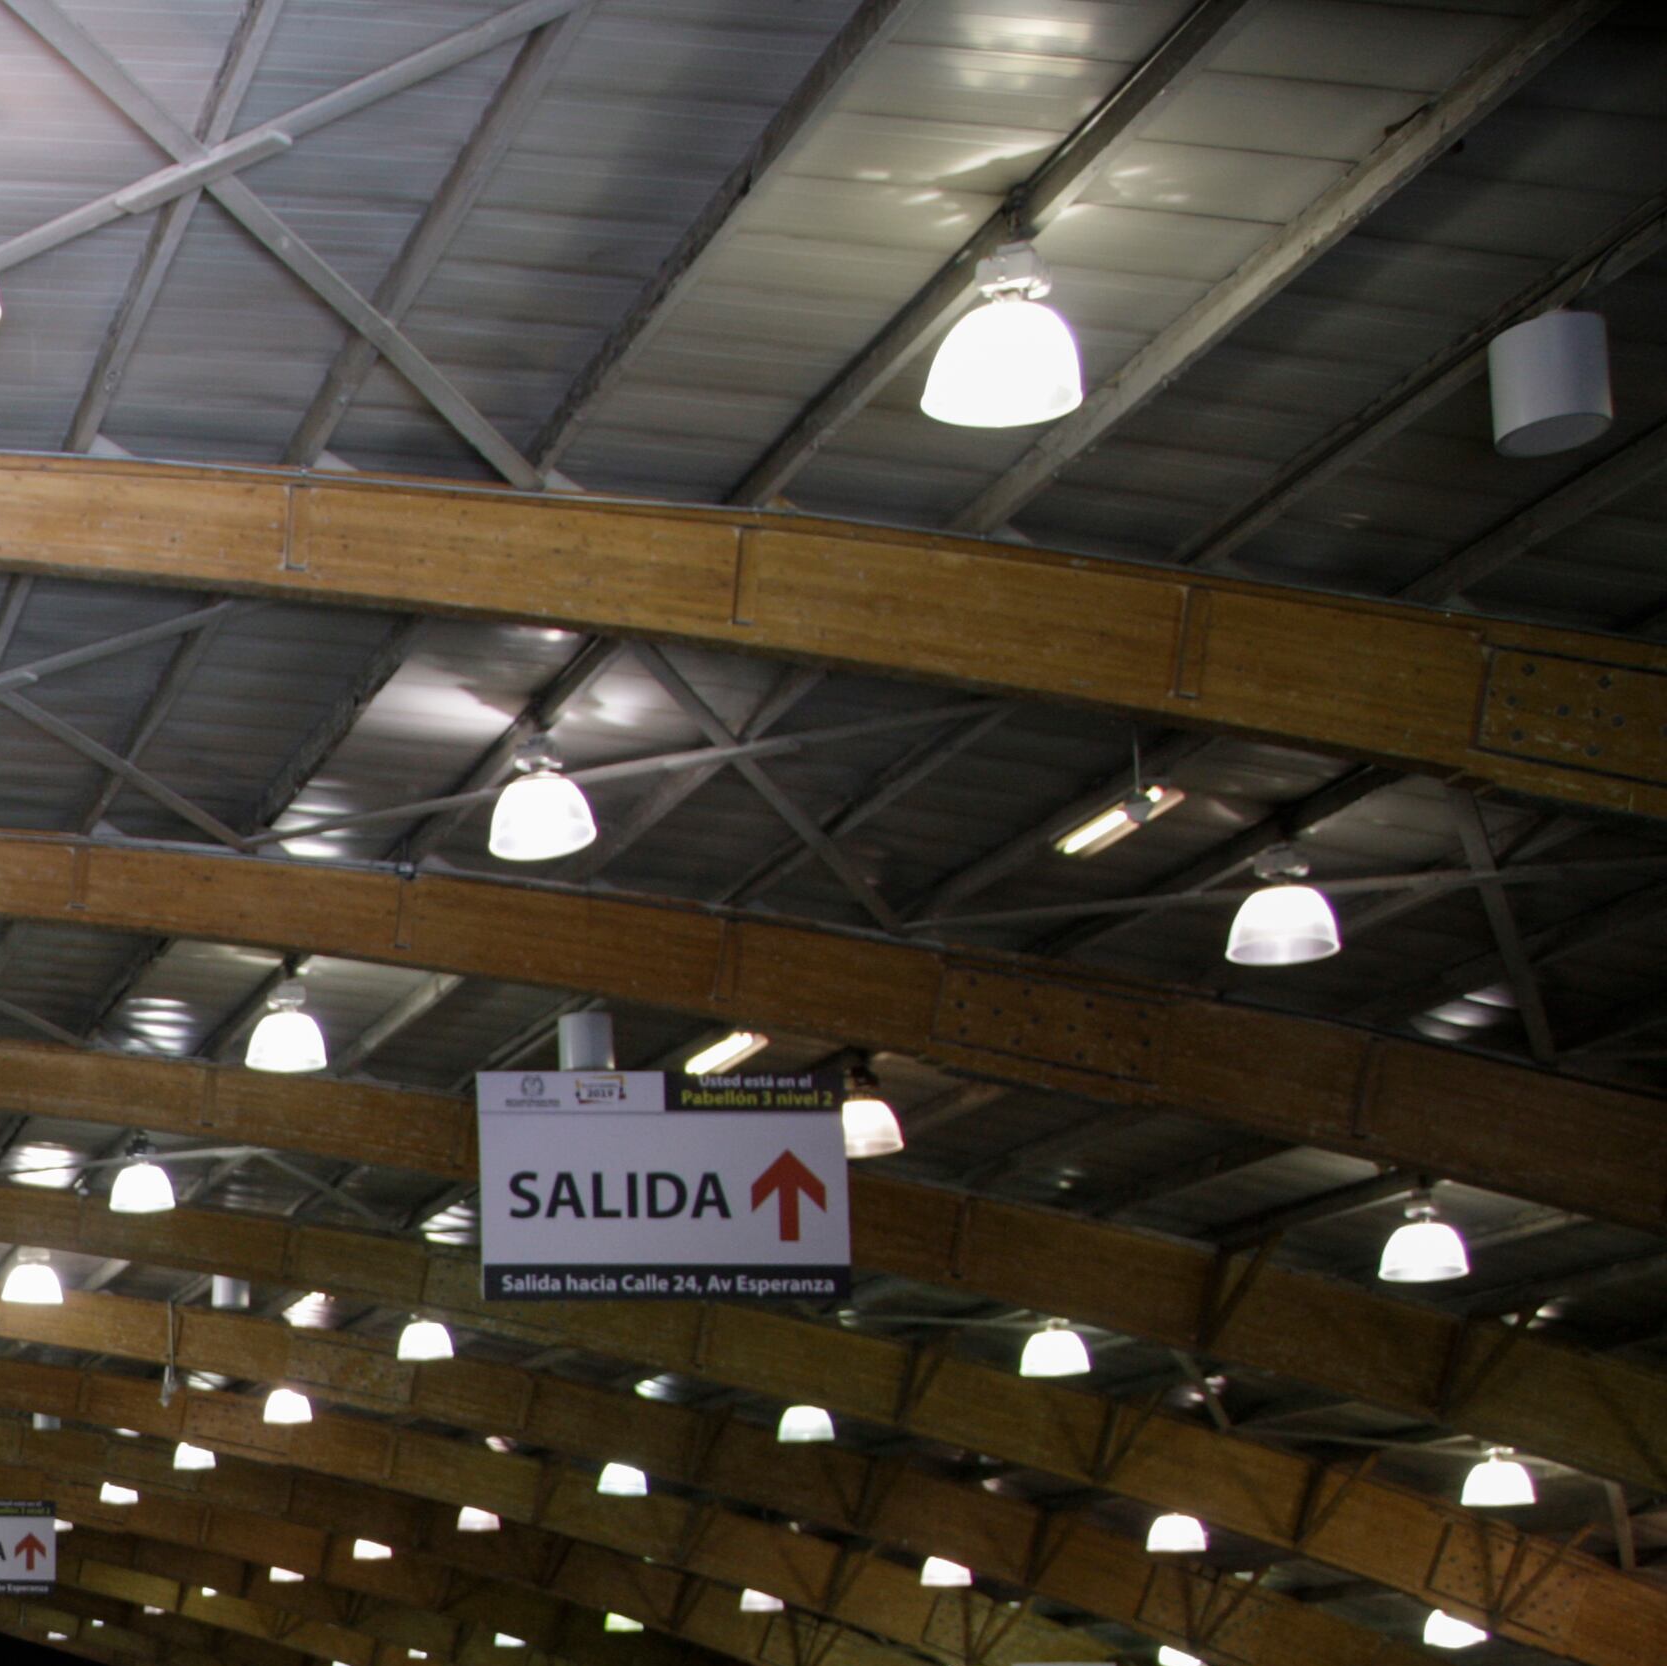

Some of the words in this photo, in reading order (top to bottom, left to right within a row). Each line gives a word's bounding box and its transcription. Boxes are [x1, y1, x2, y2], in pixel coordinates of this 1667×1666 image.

[698, 1074, 740, 1089] Usted
[743, 1073, 773, 1089] está
[778, 1077, 796, 1089] en
[799, 1074, 812, 1089] el
[681, 1090, 757, 1107] Pabellón
[761, 1091, 772, 1106] 3
[775, 1090, 819, 1106] nivel
[822, 1091, 833, 1106] 2
[509, 1171, 731, 1219] SALIDA
[501, 1274, 562, 1293] Salida
[566, 1274, 617, 1293] hacia
[622, 1274, 669, 1293] Calle
[672, 1276, 704, 1296] 24,
[707, 1277, 733, 1294] Av
[736, 1276, 836, 1298] Esperanza
